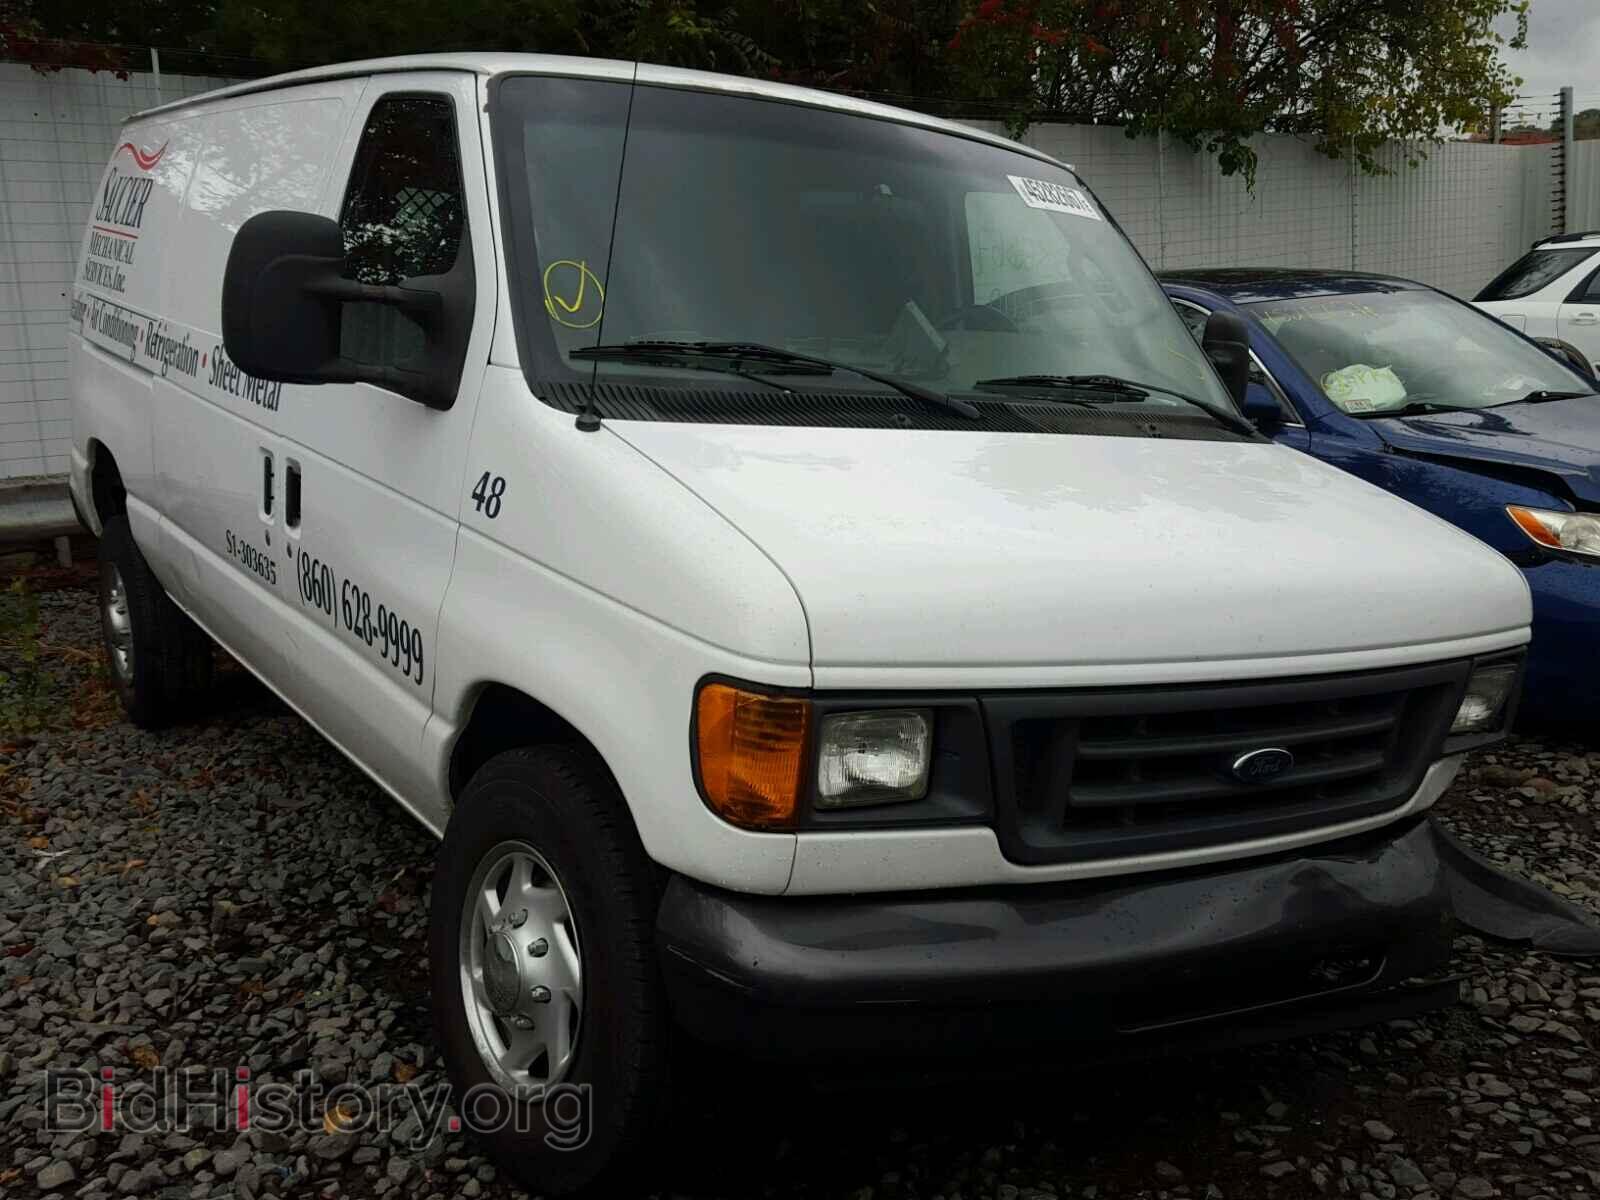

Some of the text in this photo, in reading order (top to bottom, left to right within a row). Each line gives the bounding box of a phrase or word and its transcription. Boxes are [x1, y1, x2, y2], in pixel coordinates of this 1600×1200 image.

[95, 167, 154, 229] SAUCIER
[88, 231, 136, 264] MECHANICAL
[99, 302, 139, 362] Conditioning
[144, 319, 199, 377] Refrigeration
[208, 344, 241, 396] Sheet
[241, 375, 281, 412] Metal
[471, 471, 506, 519] 48
[297, 546, 423, 685] (860) 628-9999
